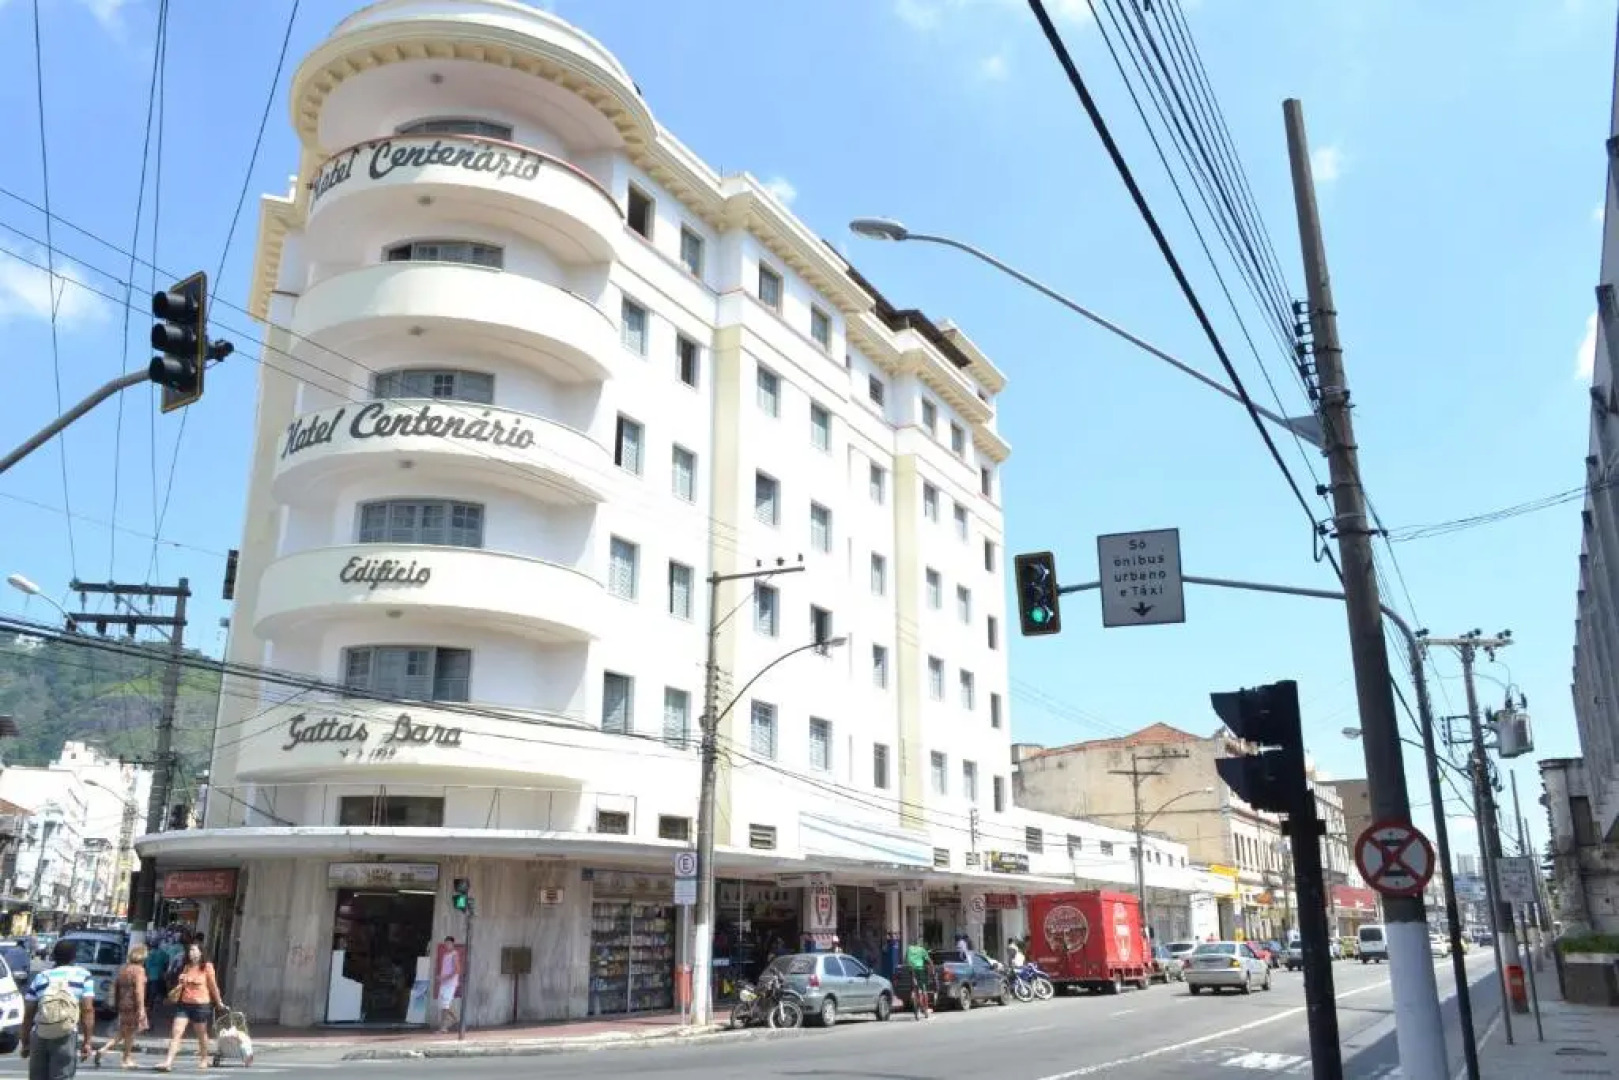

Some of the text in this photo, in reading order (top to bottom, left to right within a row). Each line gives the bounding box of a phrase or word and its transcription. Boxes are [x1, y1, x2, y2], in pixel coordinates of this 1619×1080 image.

[311, 140, 542, 205] Hotel Centenário
[281, 402, 535, 460] Hotel Centenário
[1129, 540, 1147, 551] Só
[1114, 570, 1167, 583] urbano
[1120, 589, 1127, 597] e
[682, 858, 690, 871] E
